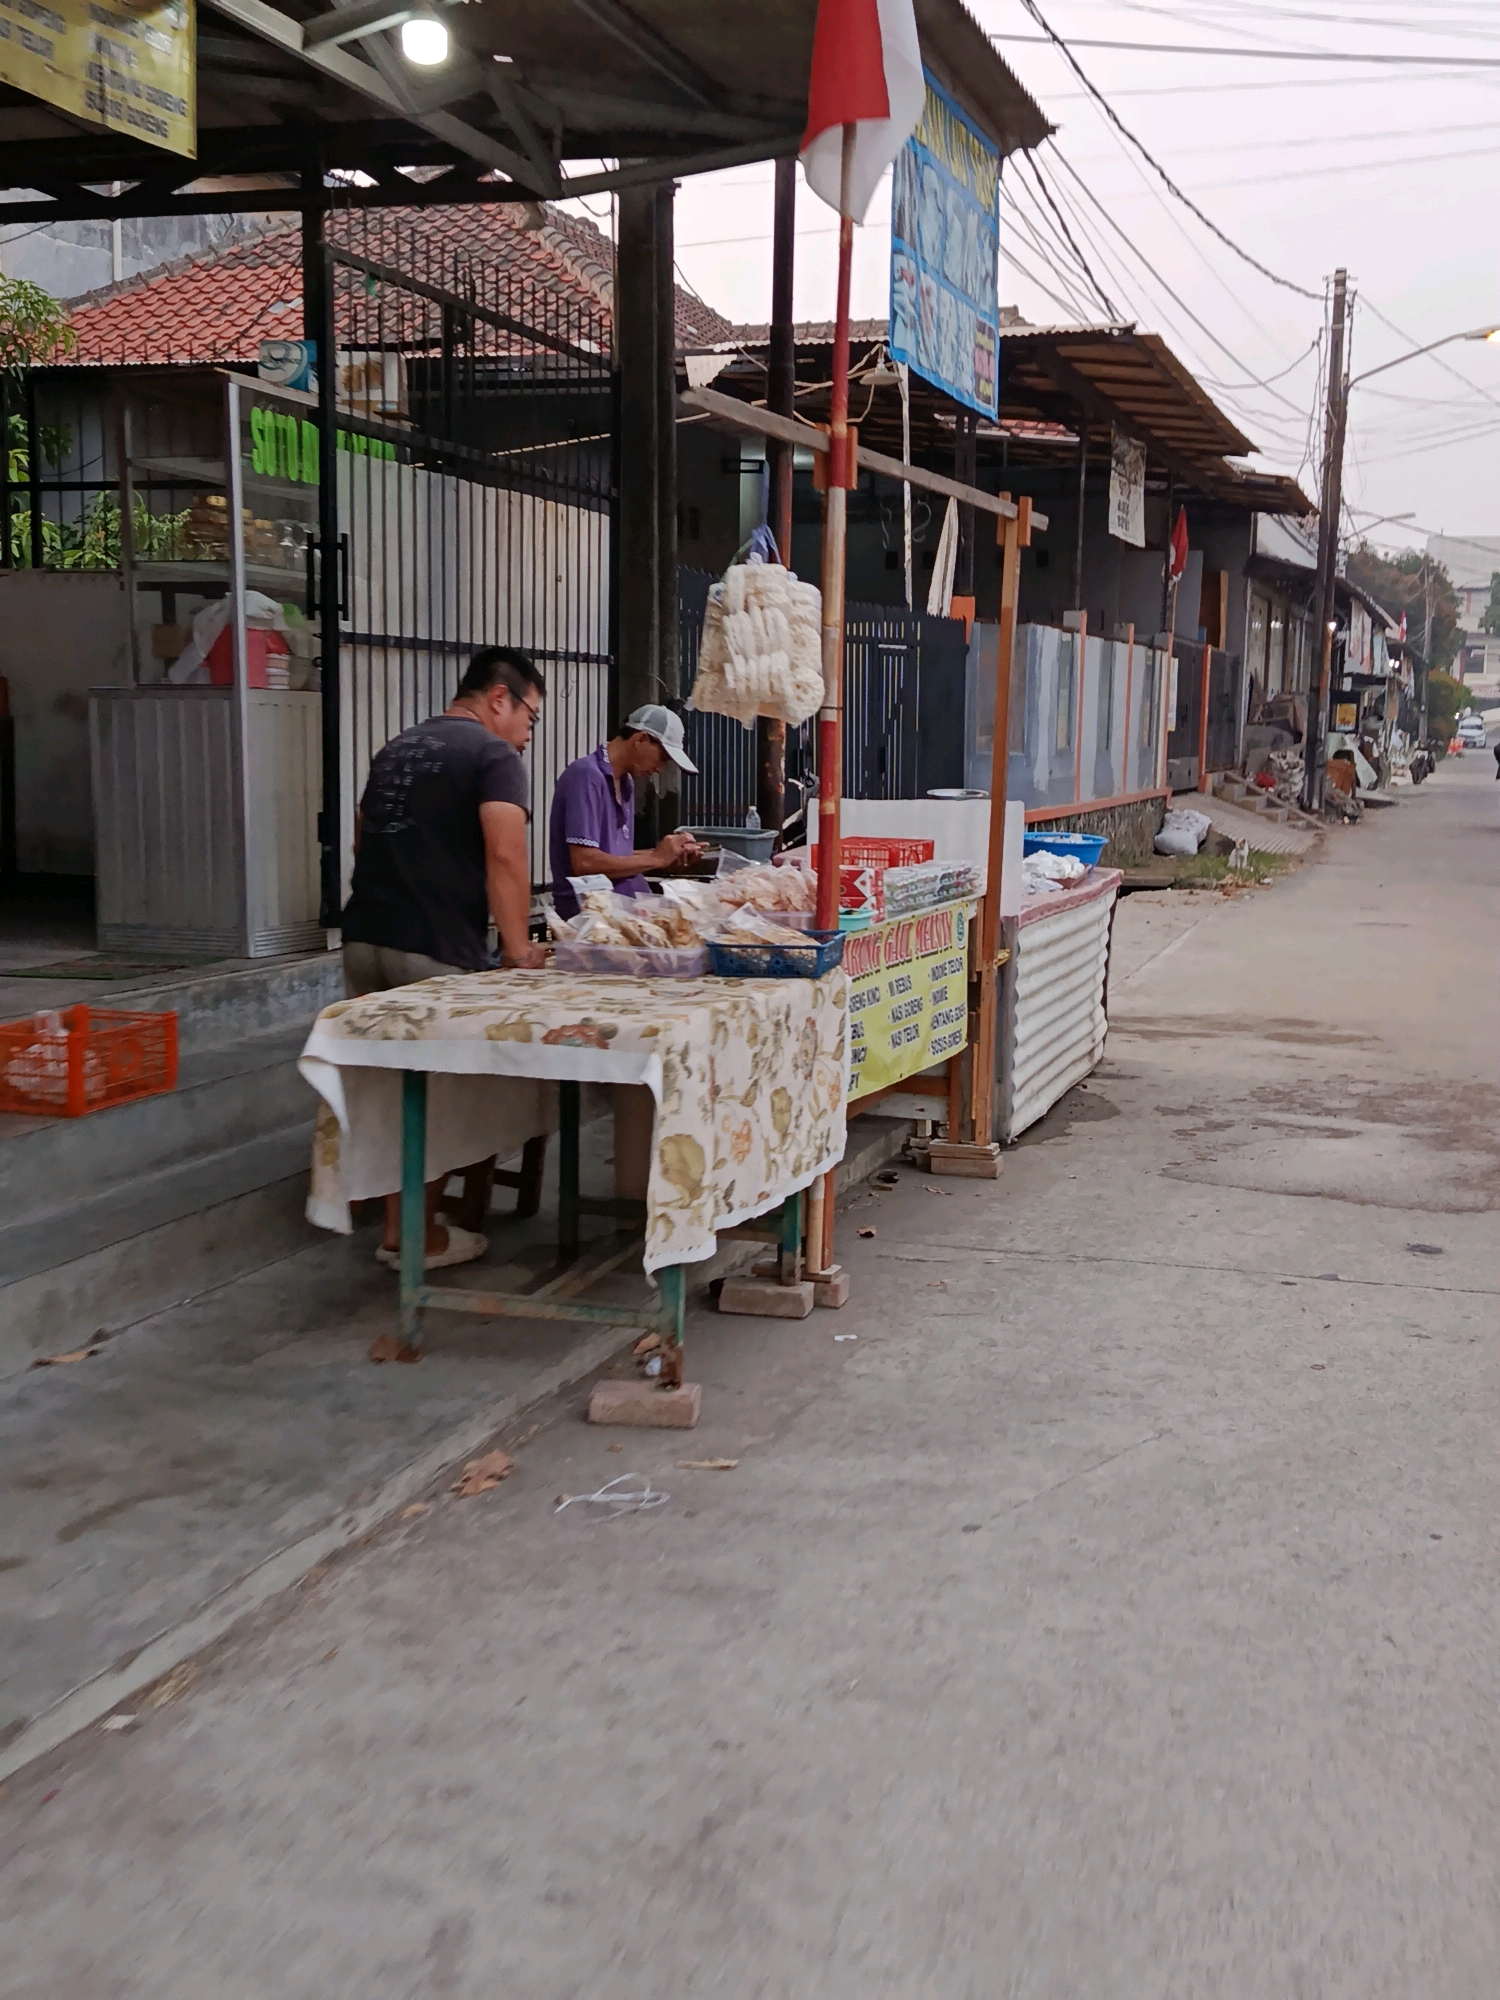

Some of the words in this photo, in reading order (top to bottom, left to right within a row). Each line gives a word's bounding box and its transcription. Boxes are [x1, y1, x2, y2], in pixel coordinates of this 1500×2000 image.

[844, 931, 883, 982] ARUNG
[849, 992, 866, 1013] ORENG
[851, 1021, 865, 1040] EBUS
